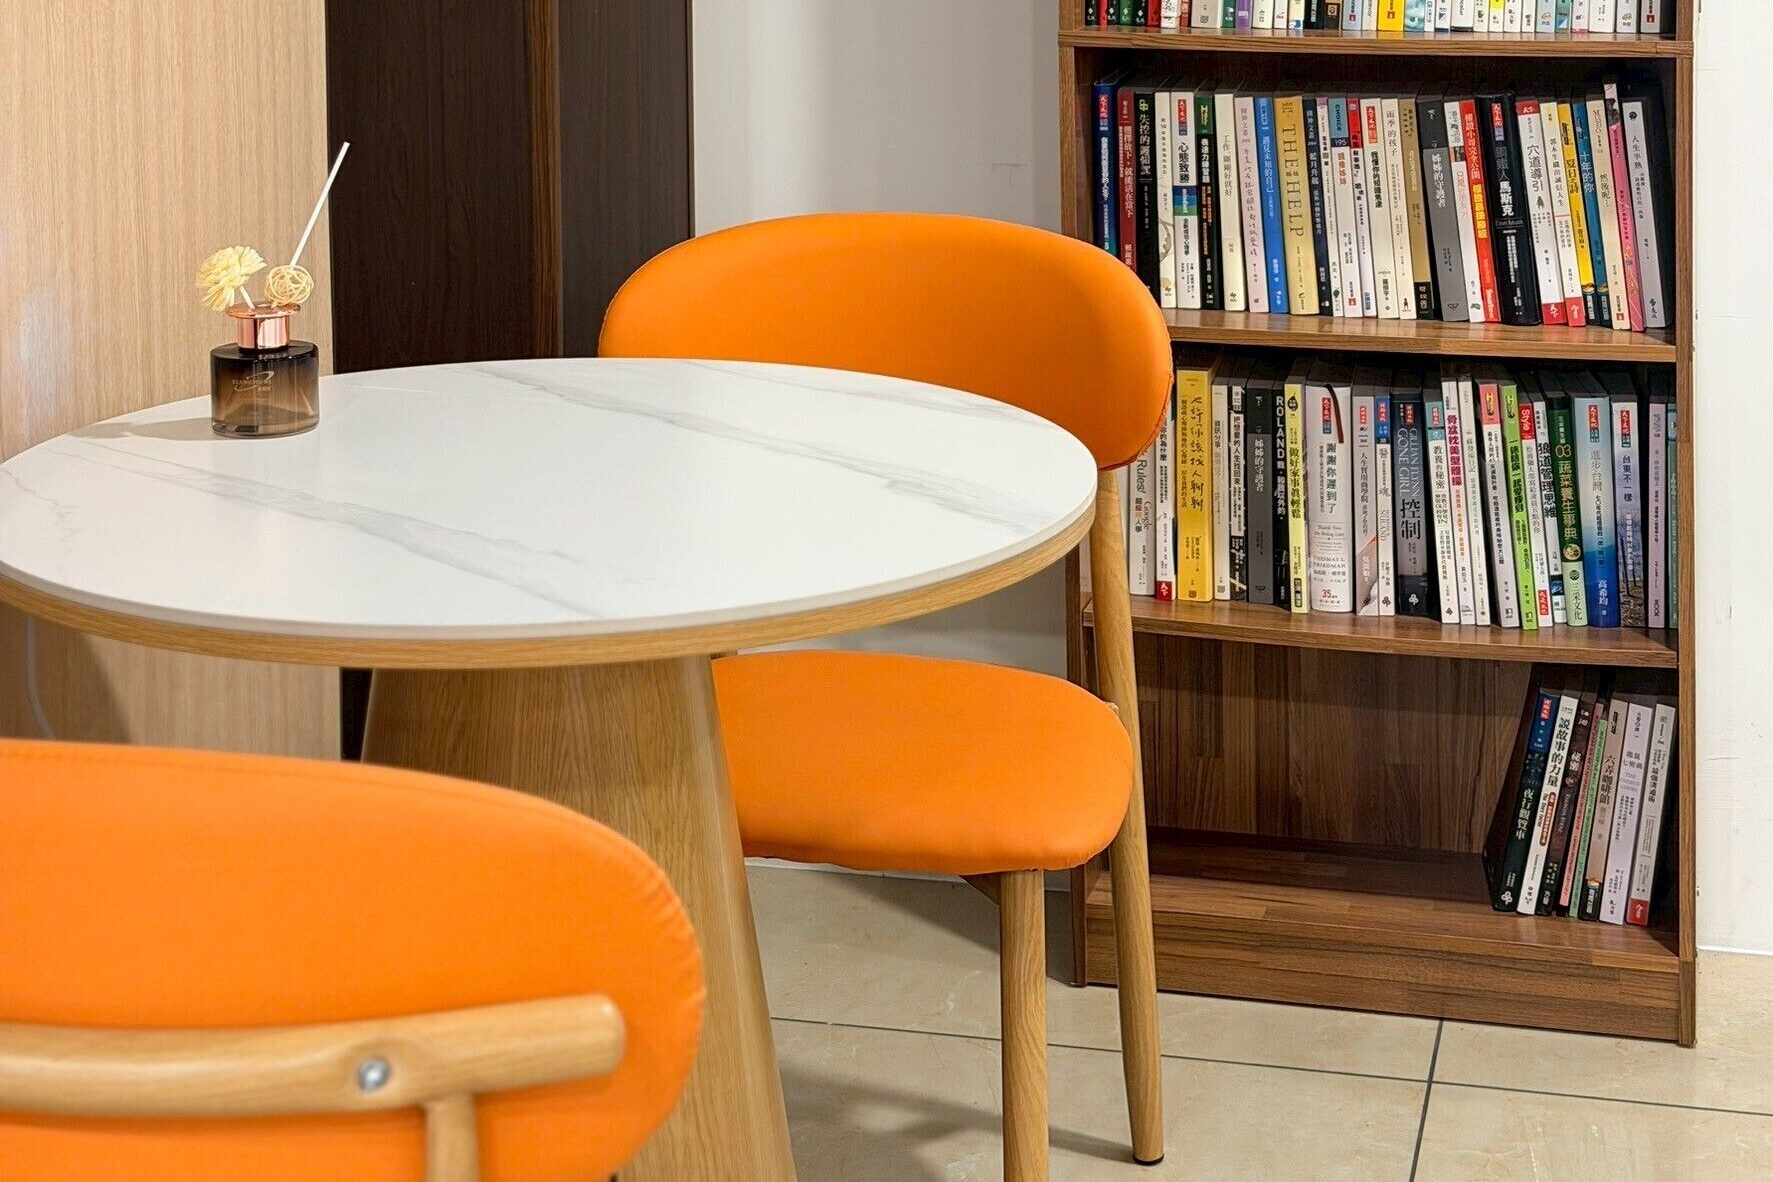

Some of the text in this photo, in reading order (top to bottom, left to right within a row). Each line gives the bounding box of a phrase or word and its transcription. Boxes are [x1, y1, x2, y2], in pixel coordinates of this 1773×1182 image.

[1178, 142, 1190, 184] 心態致勝
[1262, 135, 1275, 194] 遇見未知的自己
[1282, 123, 1304, 238] THE HELP
[1527, 144, 1544, 193] 穴道導引
[1566, 159, 1579, 194] 夏日之詩
[1275, 395, 1286, 459] ROLAND
[1520, 408, 1530, 431] Style
[1621, 407, 1630, 435] 天下文化
[1190, 396, 1205, 512] 也許你該找人聊聊
[1233, 415, 1241, 485] 把想要的人生找回來
[1397, 427, 1410, 494] GONE GIRL
[1409, 427, 1420, 497] GILLIAN FLYNN
[1555, 444, 1572, 457] 03
[1136, 459, 1148, 494] Rules!
[1326, 443, 1337, 514] 謝謝你遲到了
[1537, 442, 1557, 518] 狼道管理思維
[1622, 455, 1632, 503] 台東不一樣
[1143, 500, 1153, 530] Google
[1400, 498, 1421, 541] 控制
[1321, 589, 1332, 599] 35
[1571, 584, 1583, 620] 三采文化
[1597, 579, 1609, 606] 高希均
[1547, 717, 1571, 788] 說故事的力量
